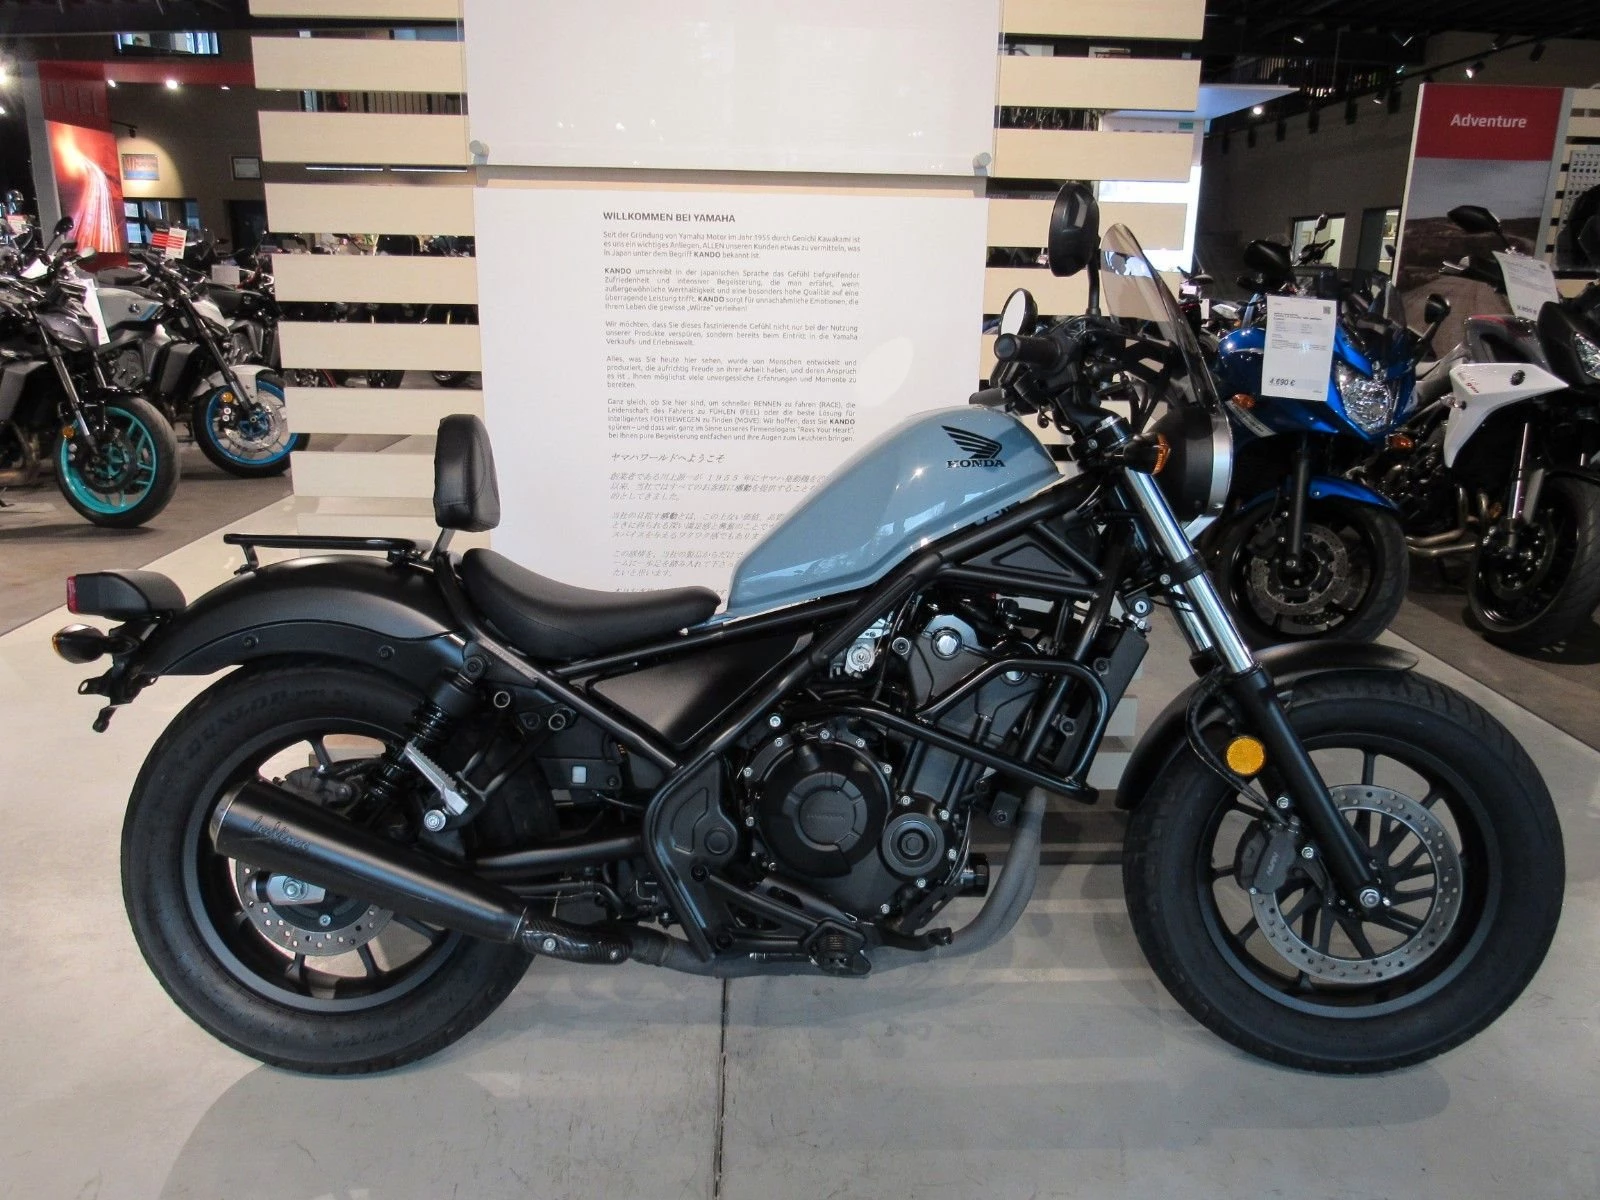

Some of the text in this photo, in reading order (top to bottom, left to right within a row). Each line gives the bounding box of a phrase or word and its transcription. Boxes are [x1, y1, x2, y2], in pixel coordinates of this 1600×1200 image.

[1450, 114, 1527, 128] Adventure
[603, 212, 736, 222] WILLKOMMEN BEI YAMAHA
[611, 452, 725, 463] ヤマハワールドへようこそ
[946, 460, 1006, 468] HONDA
